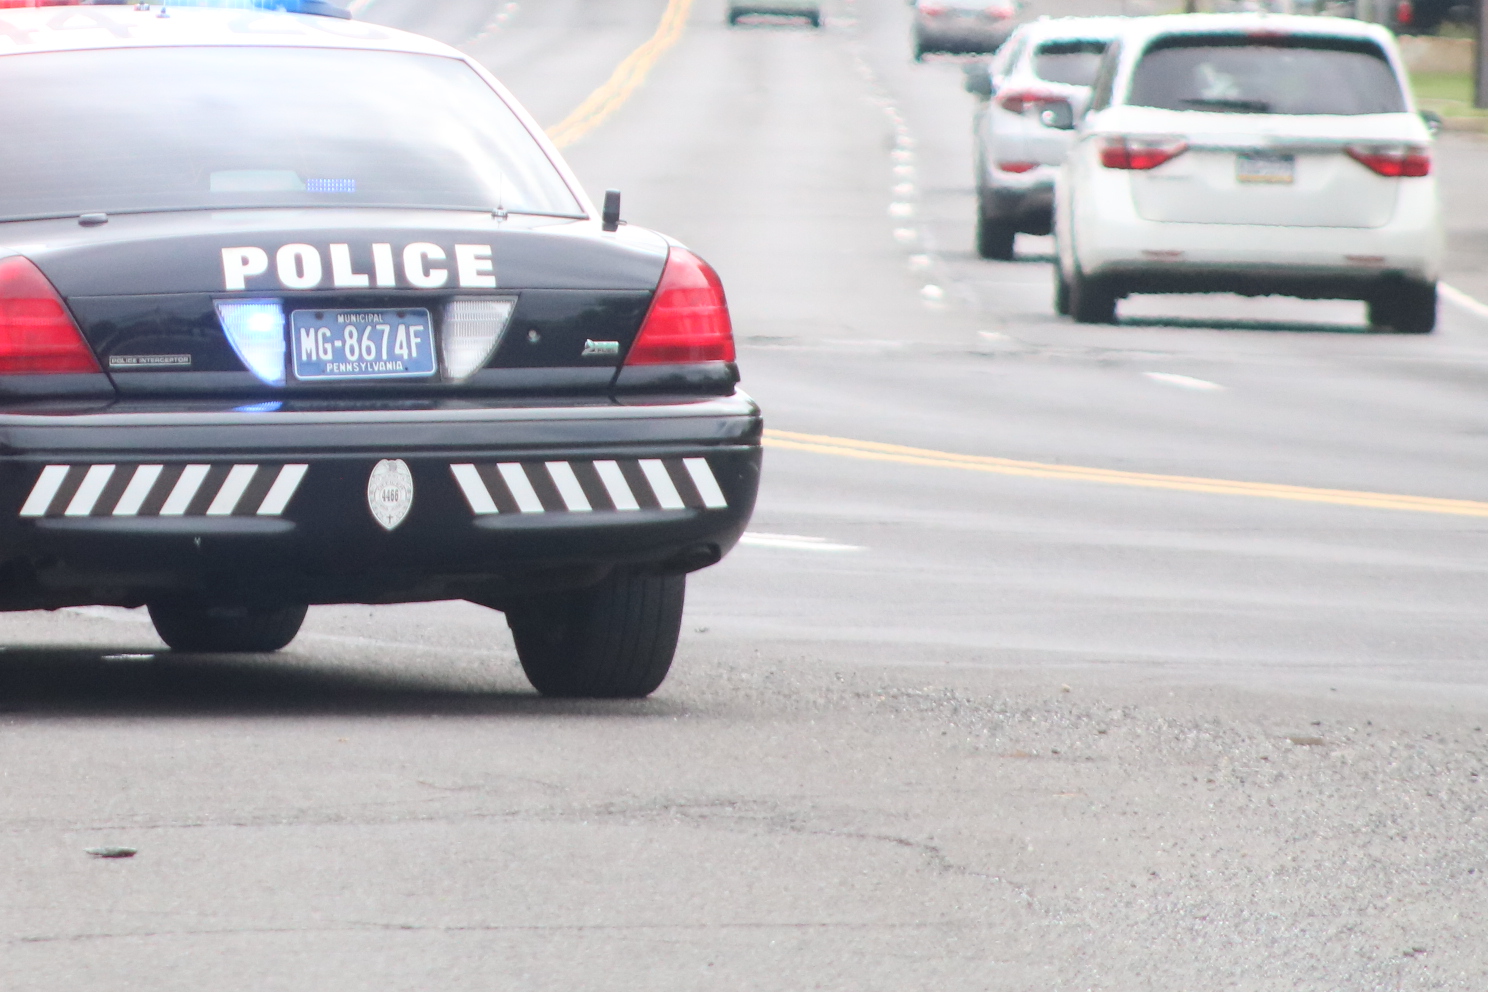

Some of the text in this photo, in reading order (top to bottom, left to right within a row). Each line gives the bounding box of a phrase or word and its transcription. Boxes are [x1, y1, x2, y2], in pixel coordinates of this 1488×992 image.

[221, 242, 497, 291] POLICE
[337, 313, 384, 324] MUNICIPAL
[300, 323, 424, 361] MG-8674F
[111, 356, 137, 364] POLICE
[326, 360, 404, 373] PENNSYLVANIA
